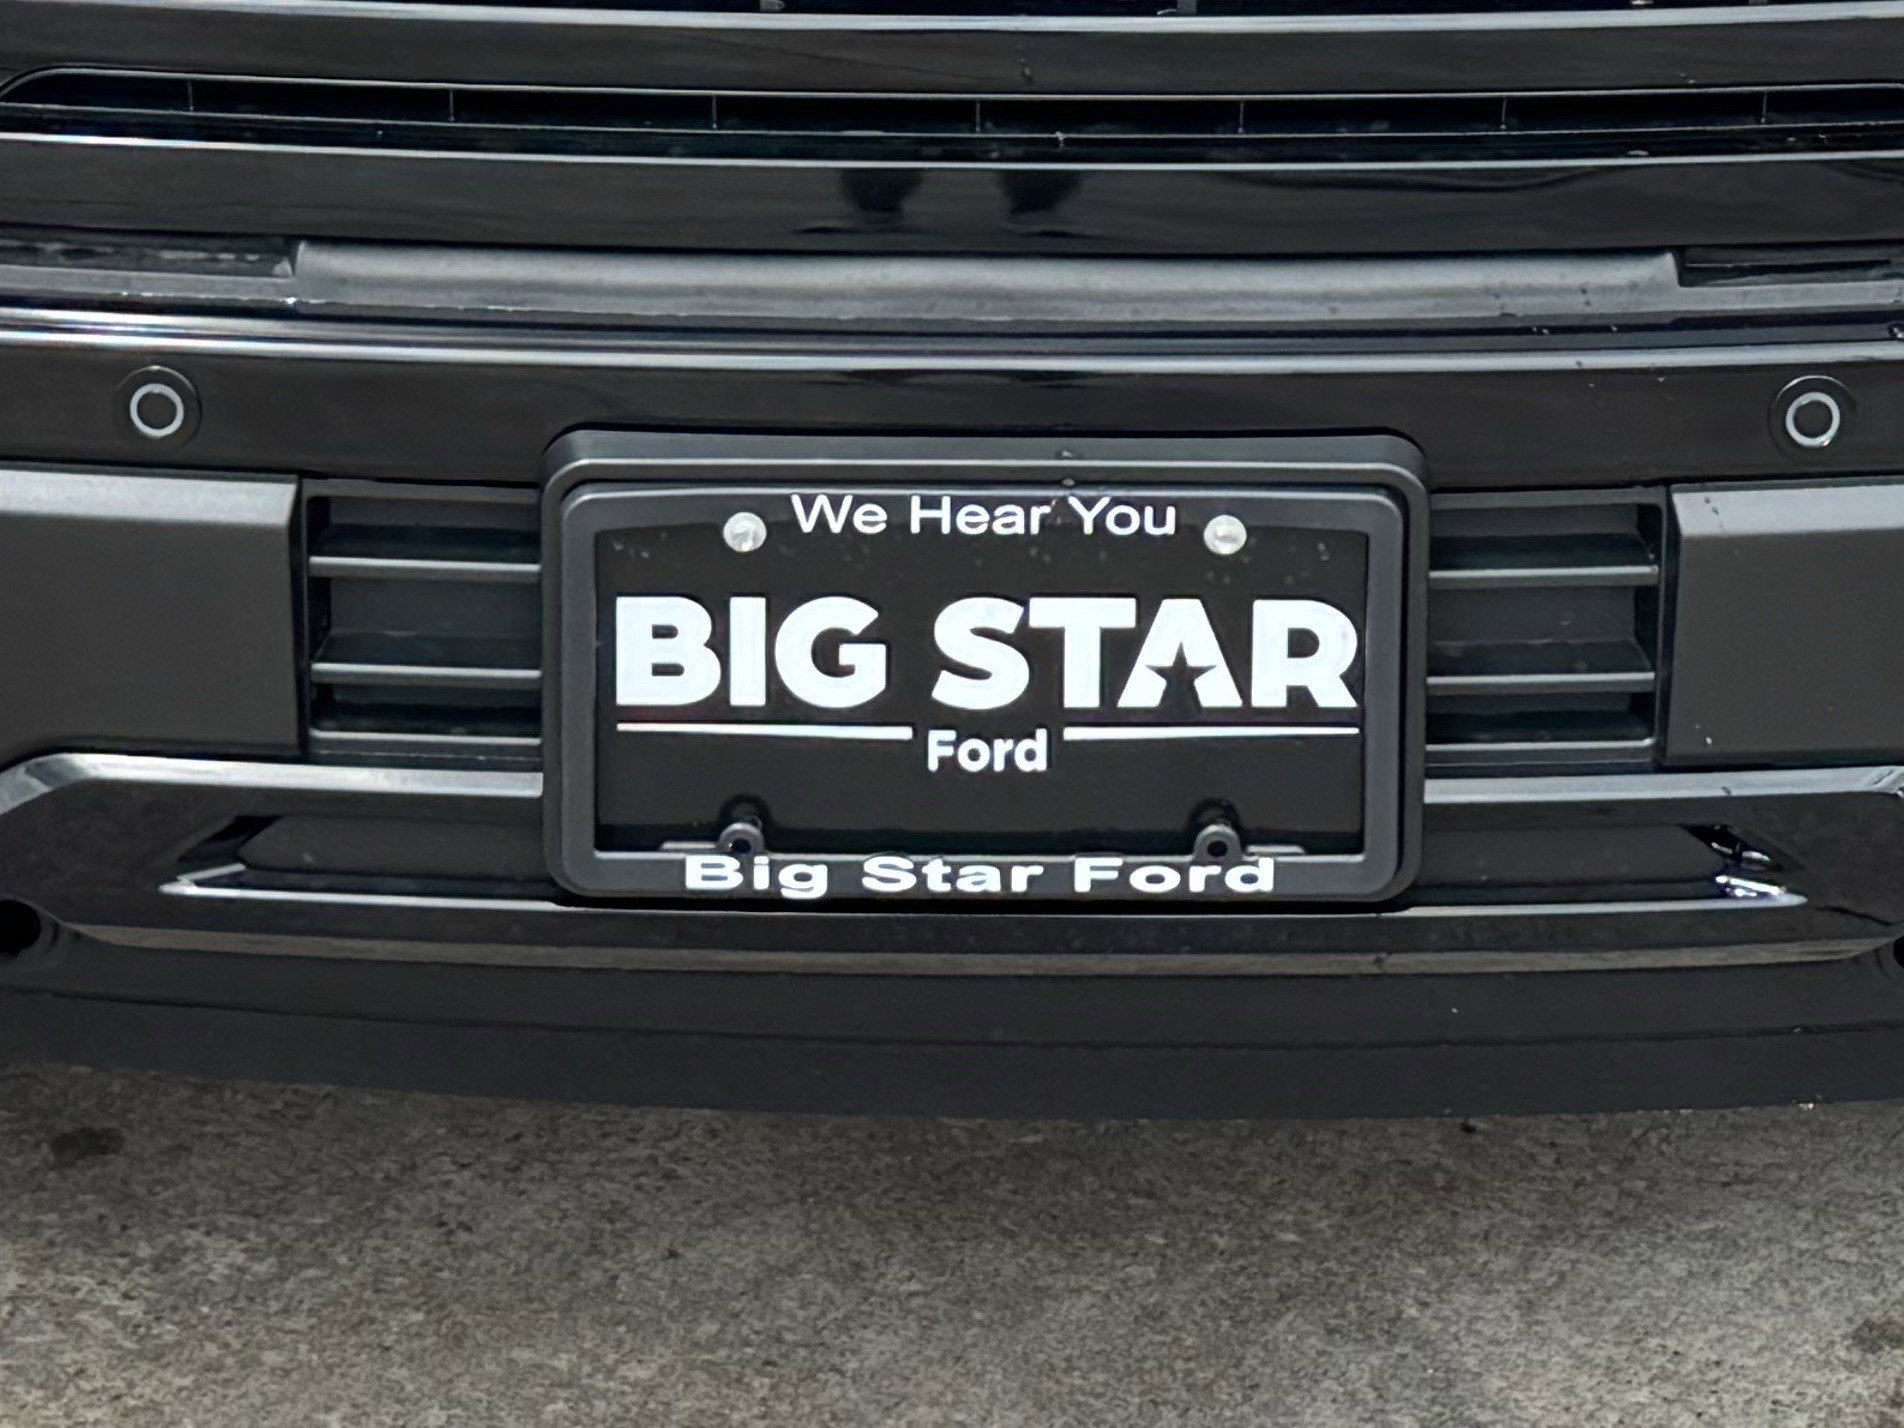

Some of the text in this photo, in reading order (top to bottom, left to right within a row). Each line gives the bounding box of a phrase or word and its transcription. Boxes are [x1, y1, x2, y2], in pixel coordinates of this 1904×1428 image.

[792, 494, 1178, 538] We Hear You
[615, 596, 1358, 711] BIG STAR
[927, 729, 1049, 773] Ford
[683, 854, 1275, 900] Big Star Ford
